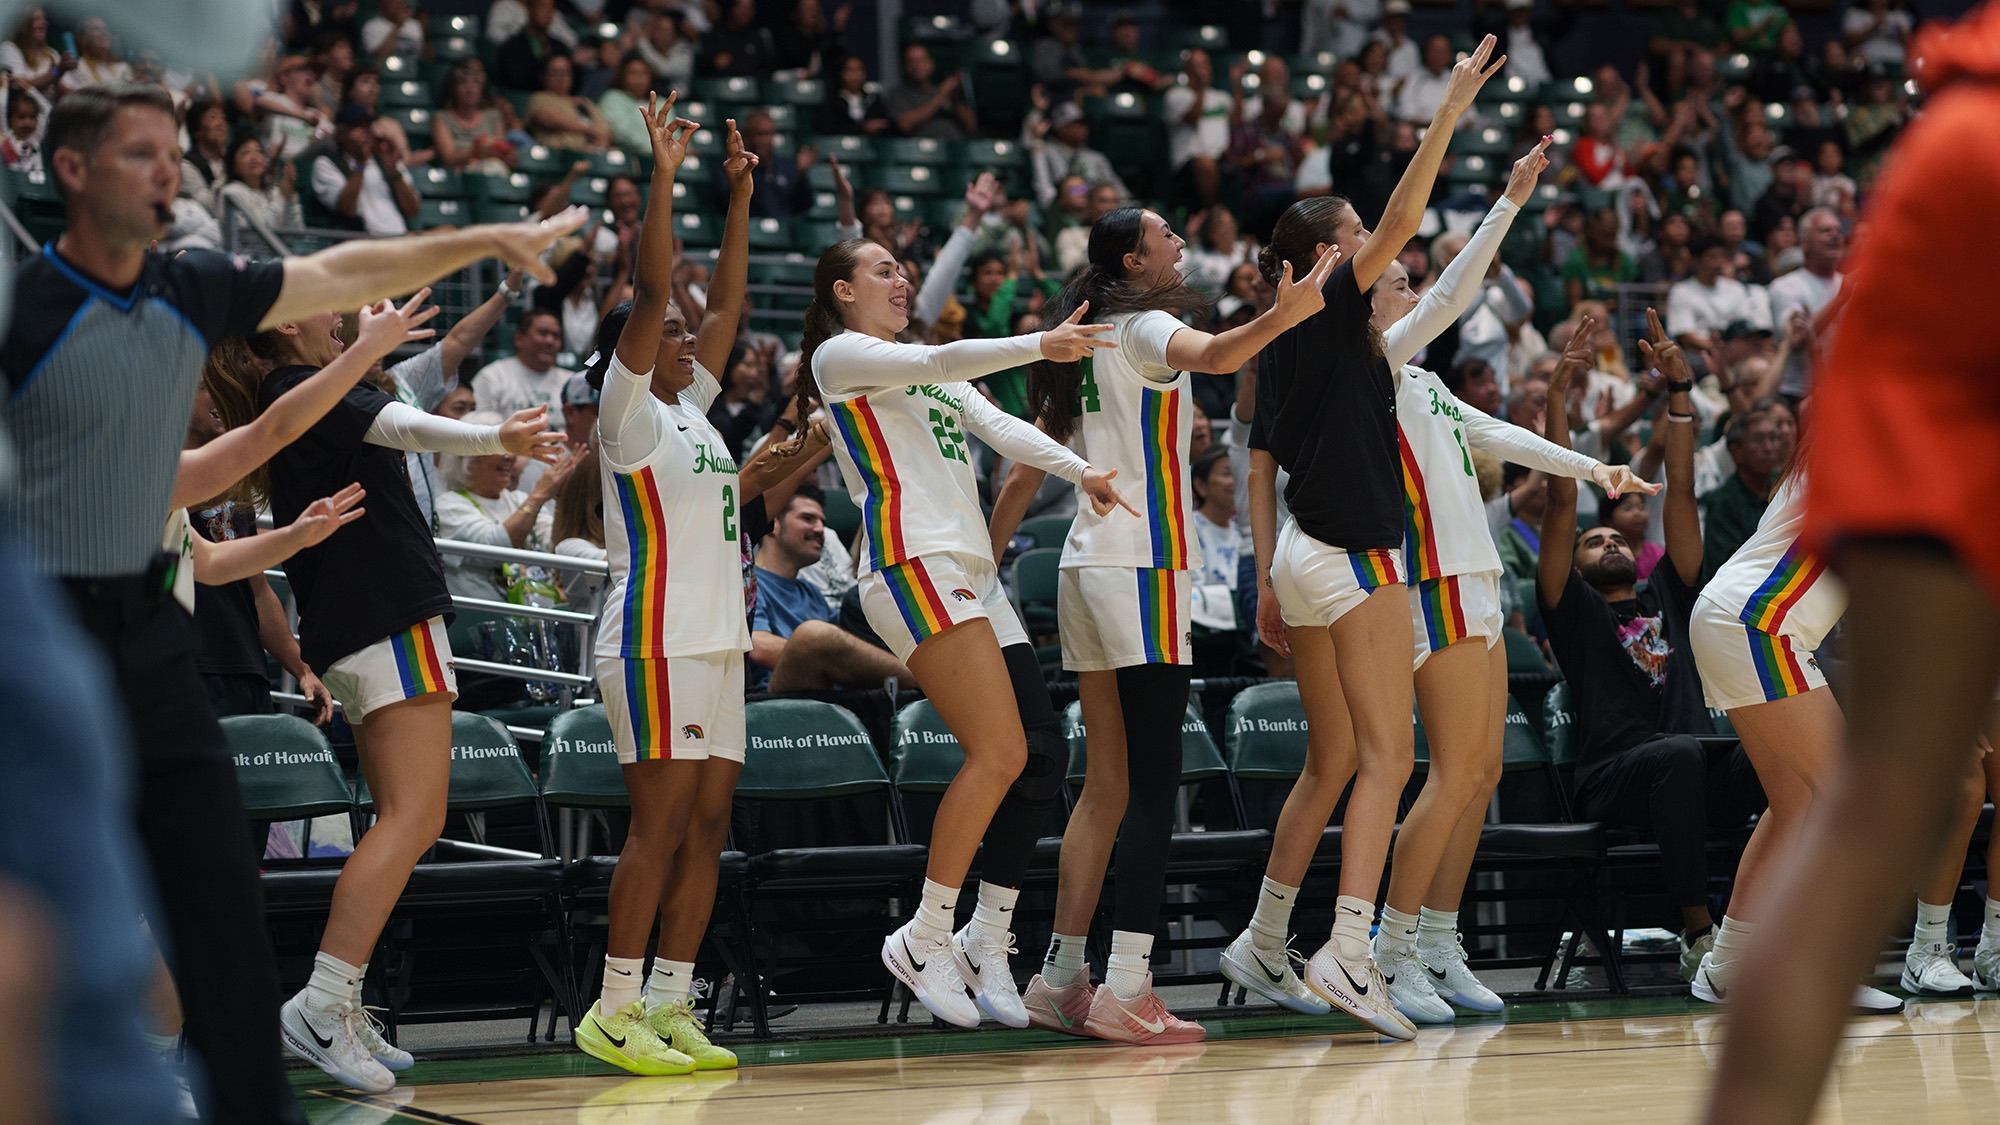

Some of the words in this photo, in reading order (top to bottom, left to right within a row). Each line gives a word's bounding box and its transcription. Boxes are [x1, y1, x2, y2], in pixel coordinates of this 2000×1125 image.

[722, 484, 737, 542] 2
[1257, 718, 1298, 732] Bank
[1300, 720, 1309, 731] o
[751, 735, 794, 749] Bank
[797, 734, 814, 748] of
[815, 731, 871, 747] Hawaii
[922, 730, 959, 744] Ban
[461, 743, 519, 760] Hawaii
[574, 739, 617, 753] Bank
[253, 752, 273, 766] of
[275, 749, 334, 765] Hawaii
